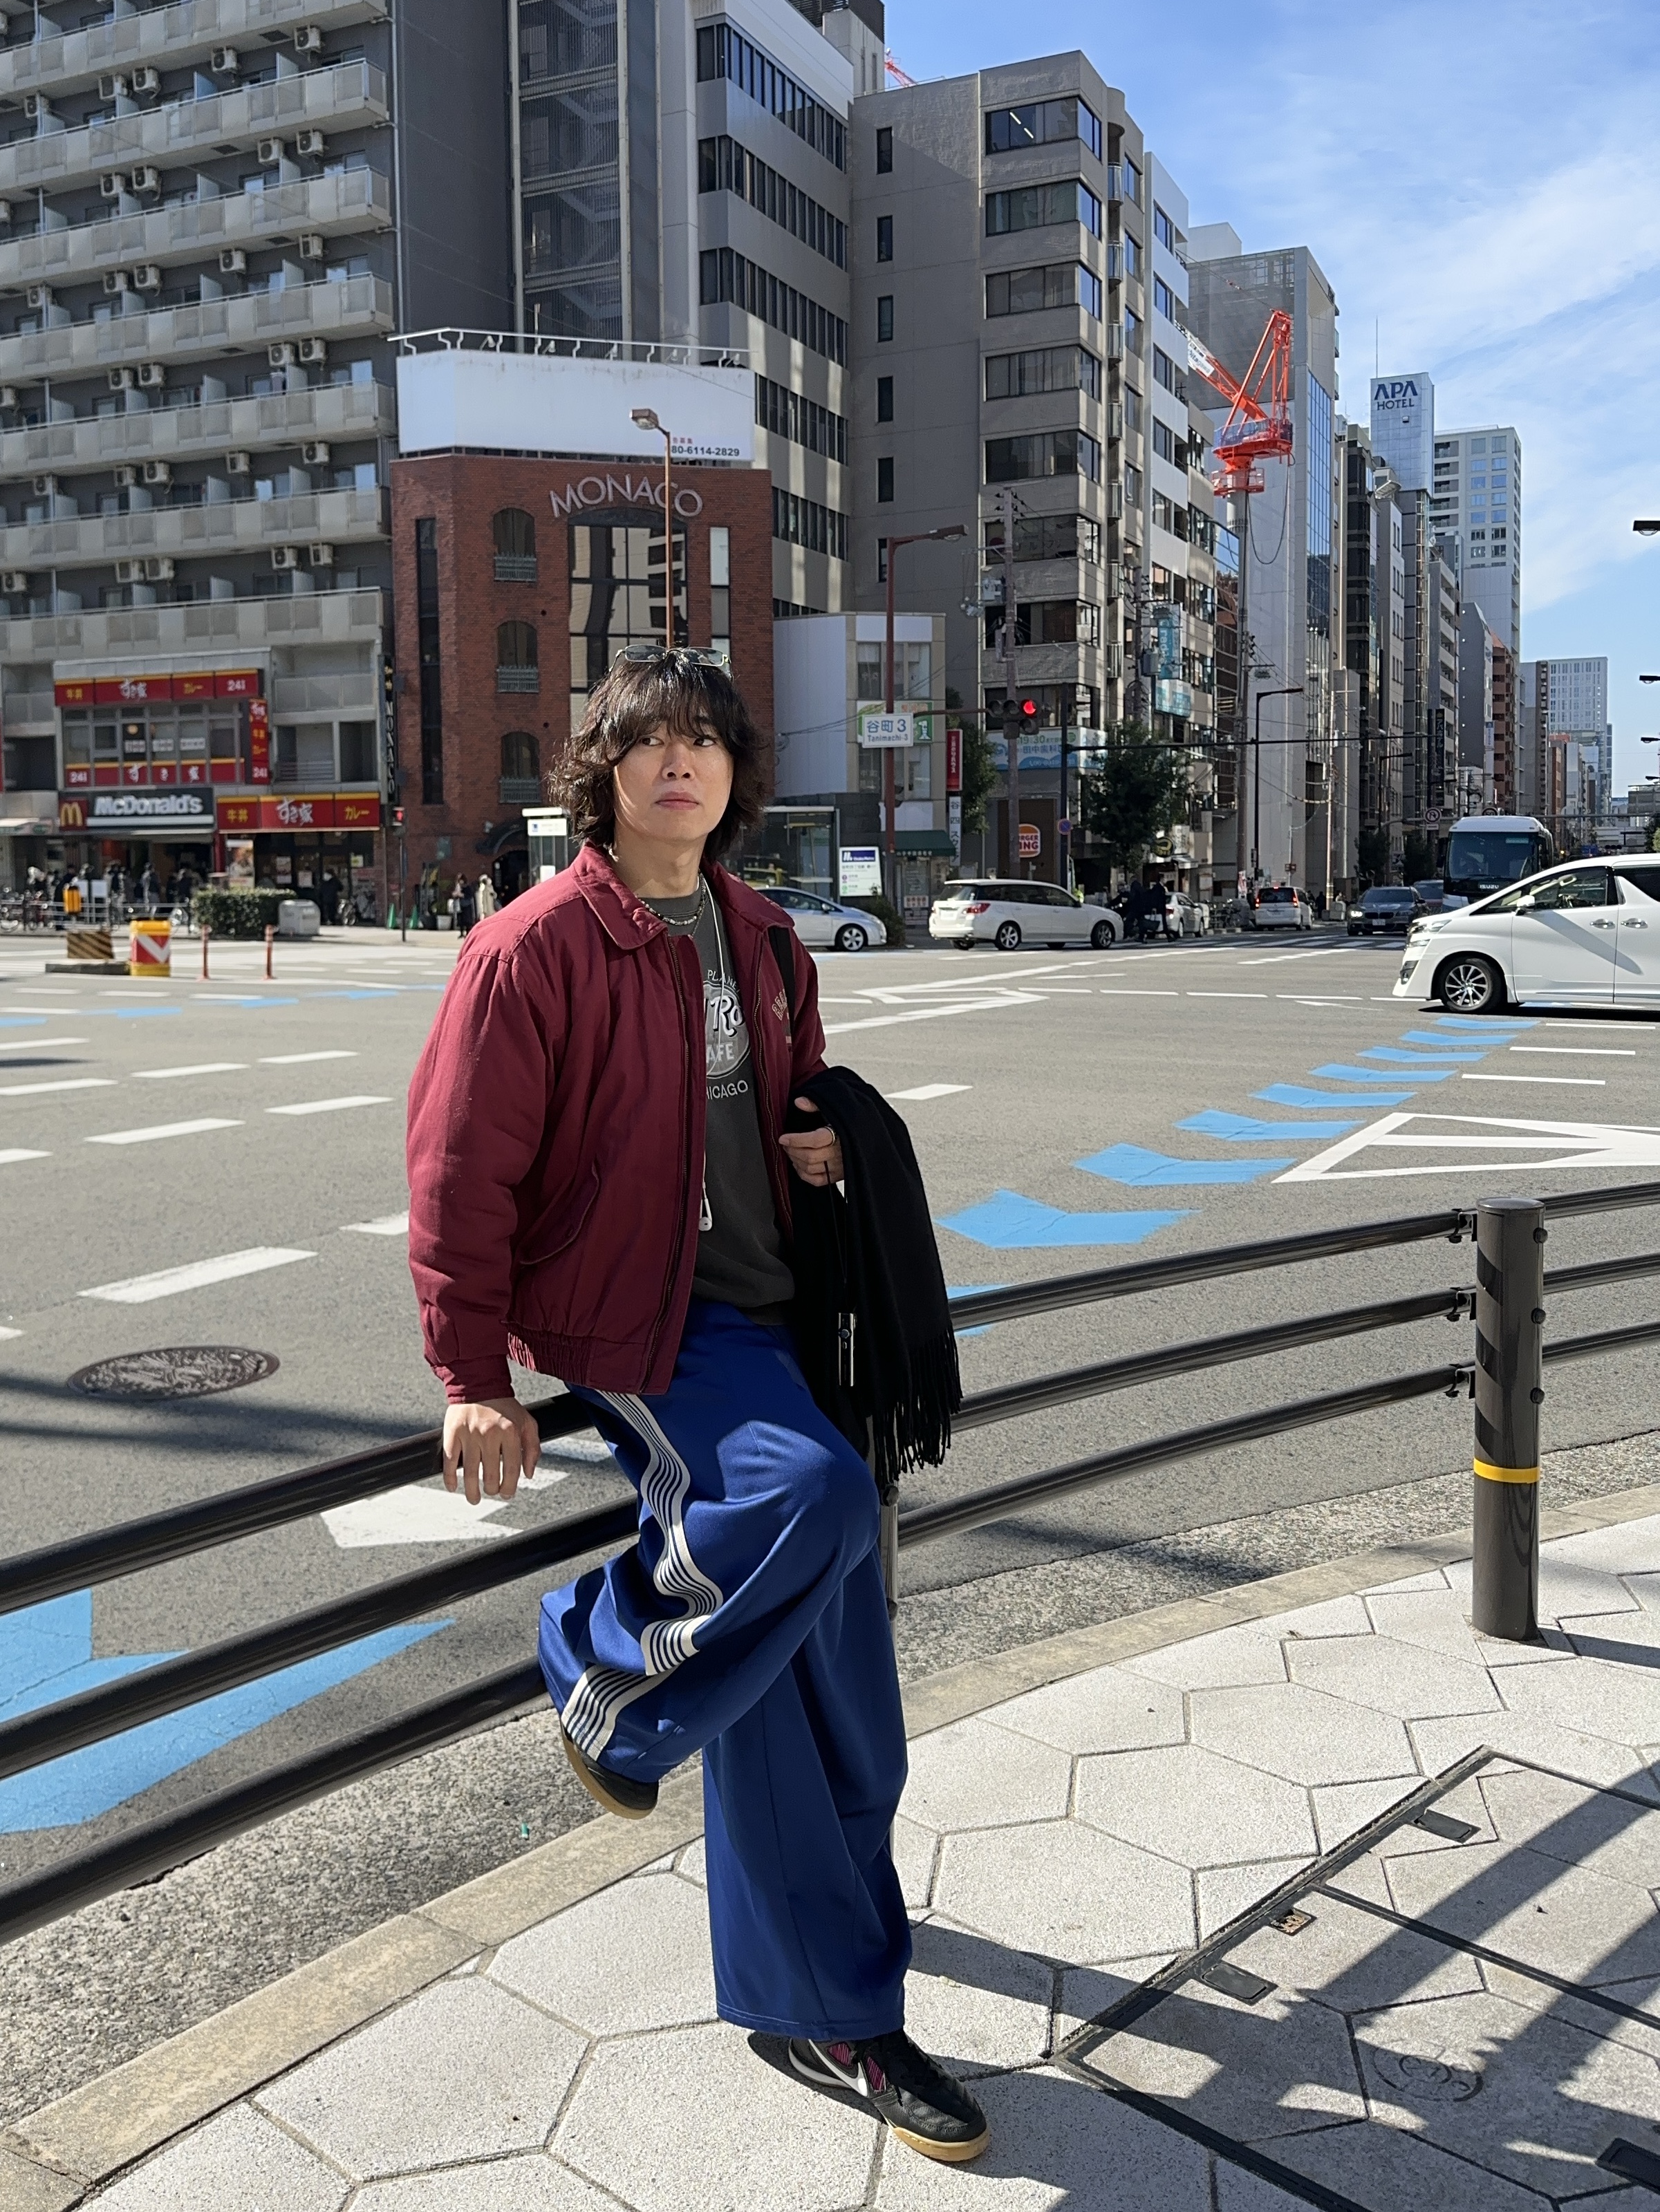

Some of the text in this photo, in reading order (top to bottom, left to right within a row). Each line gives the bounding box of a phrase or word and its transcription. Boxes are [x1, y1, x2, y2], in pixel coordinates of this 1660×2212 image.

[1374, 380, 1418, 400] APA
[1377, 398, 1415, 411] HOTEL
[671, 445, 740, 457] 80-6114-2829
[549, 474, 704, 518] MONACO
[1023, 744, 1063, 754] 田中歯科
[94, 794, 204, 816] McDonald's
[277, 796, 314, 826] すき家
[344, 805, 371, 821] カレー
[1020, 841, 1039, 850] ING
[707, 969, 740, 993] PLANE
[707, 1041, 735, 1064] AFE
[706, 1079, 749, 1100] ICAGO
